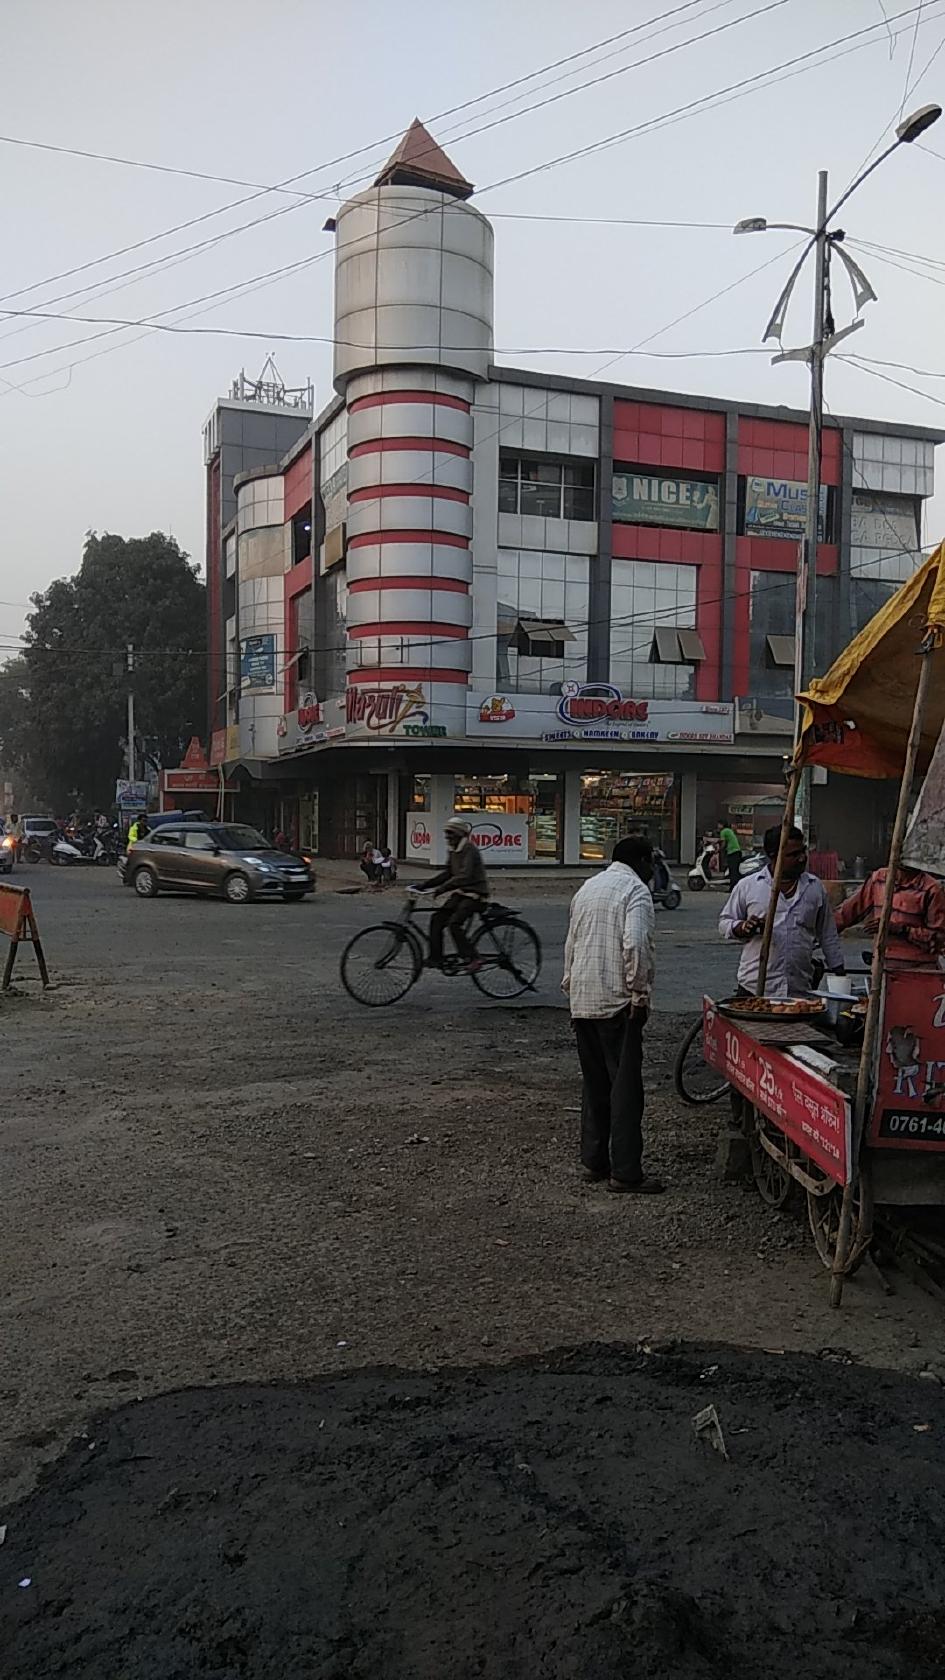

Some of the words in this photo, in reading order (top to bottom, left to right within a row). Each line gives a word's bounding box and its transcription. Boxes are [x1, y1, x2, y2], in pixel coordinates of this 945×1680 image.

[633, 478, 691, 505] NICE
[402, 724, 448, 738] TOWER
[582, 729, 621, 740] NAMKEEN
[470, 834, 523, 847] NDORE
